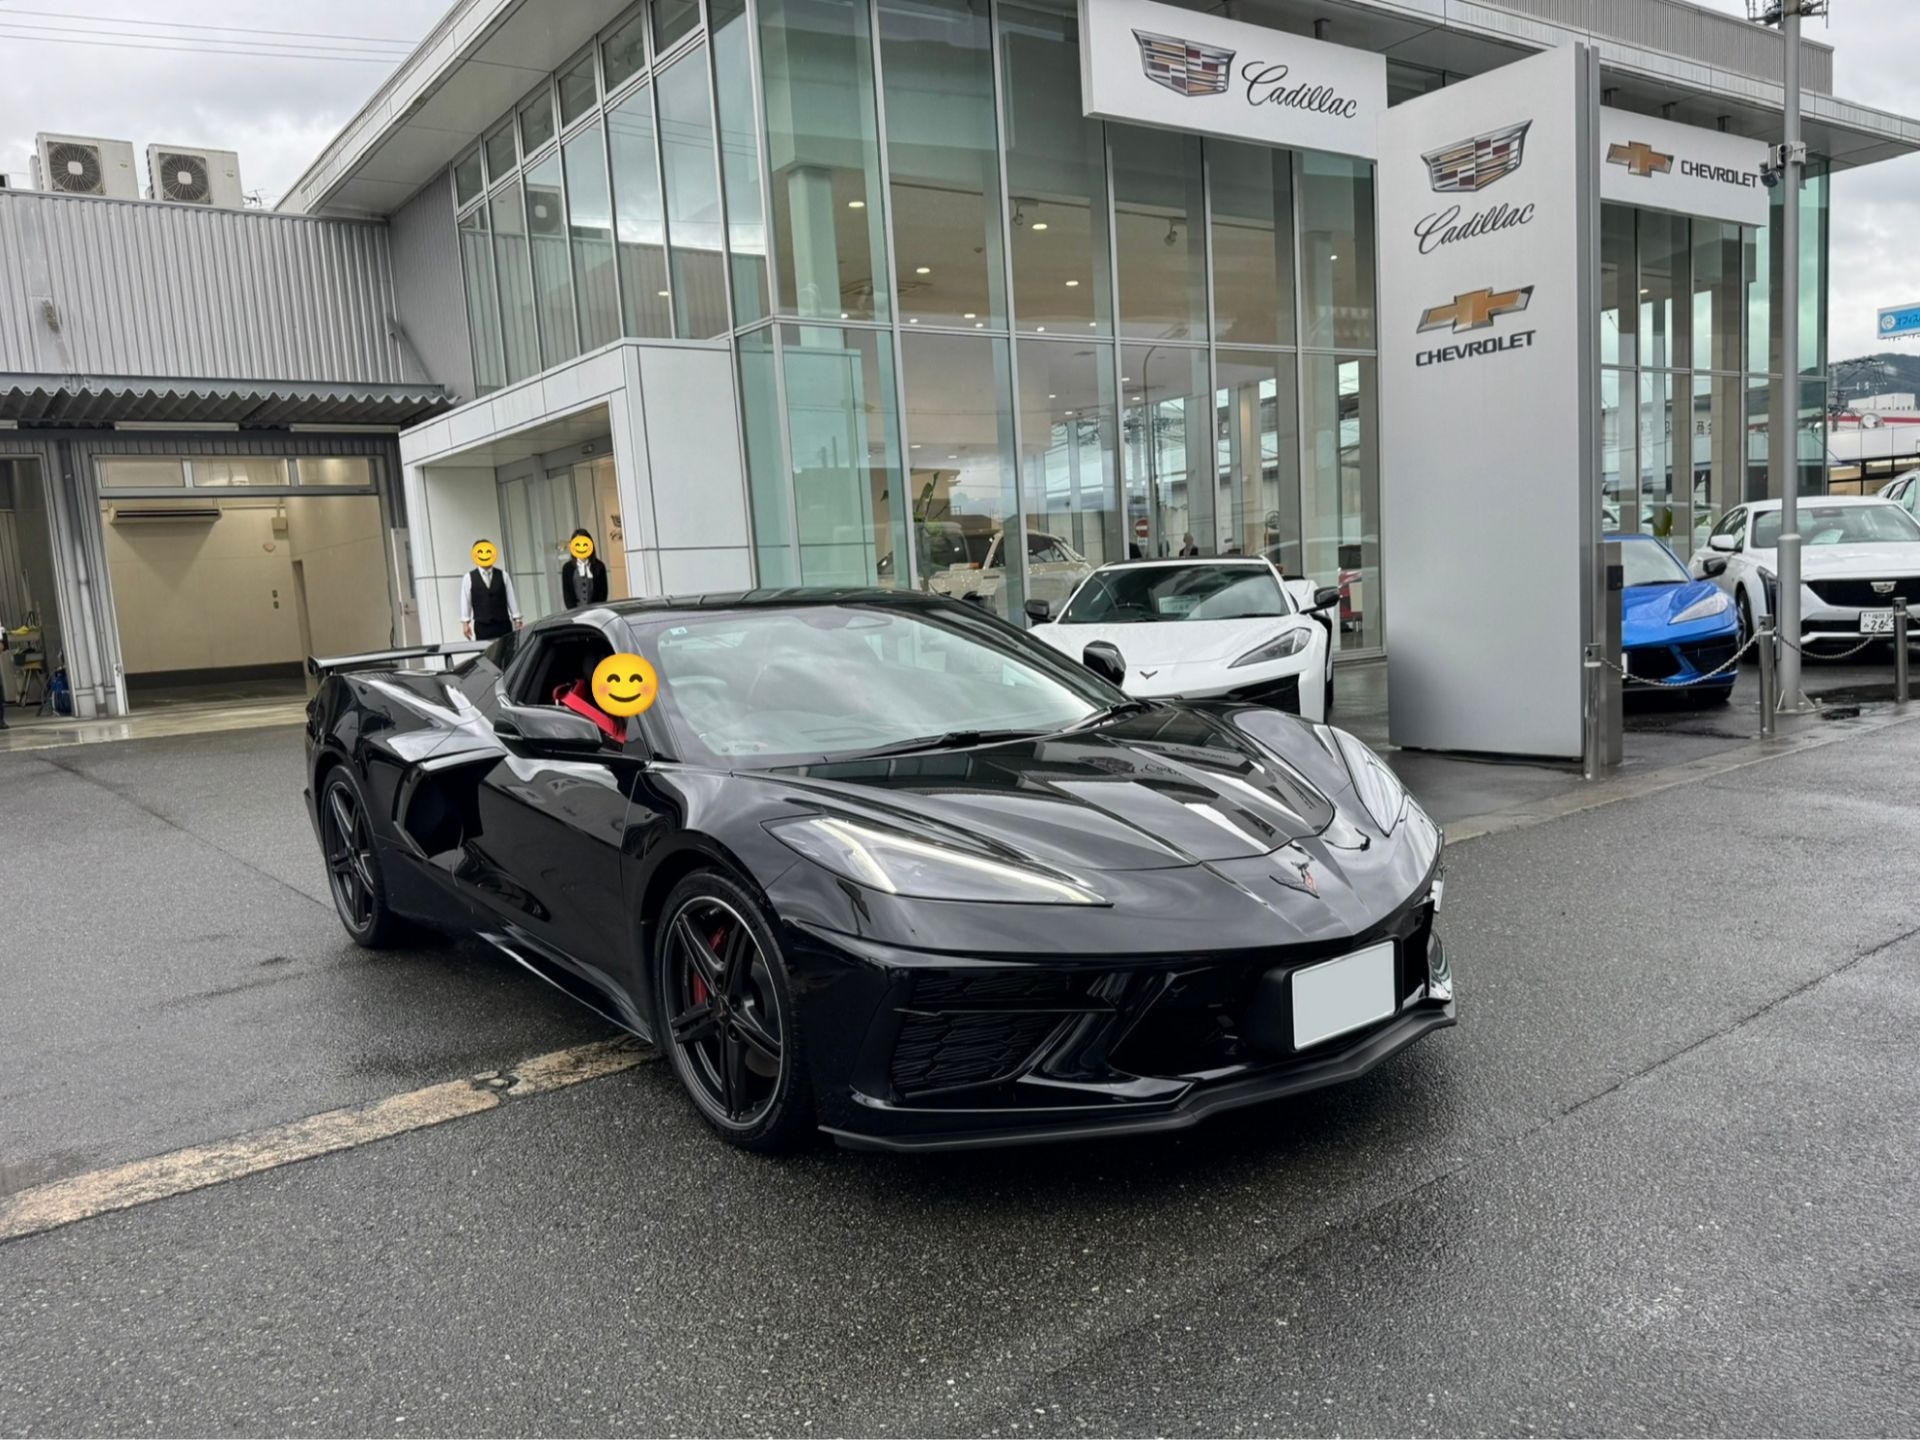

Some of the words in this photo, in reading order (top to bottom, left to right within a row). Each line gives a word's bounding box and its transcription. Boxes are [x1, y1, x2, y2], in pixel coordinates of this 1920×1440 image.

[1241, 61, 1358, 119] Cadillac
[1680, 160, 1758, 188] CHEVROLET
[1414, 202, 1535, 255] Cadillac
[1415, 330, 1536, 367] CHEVROLET
